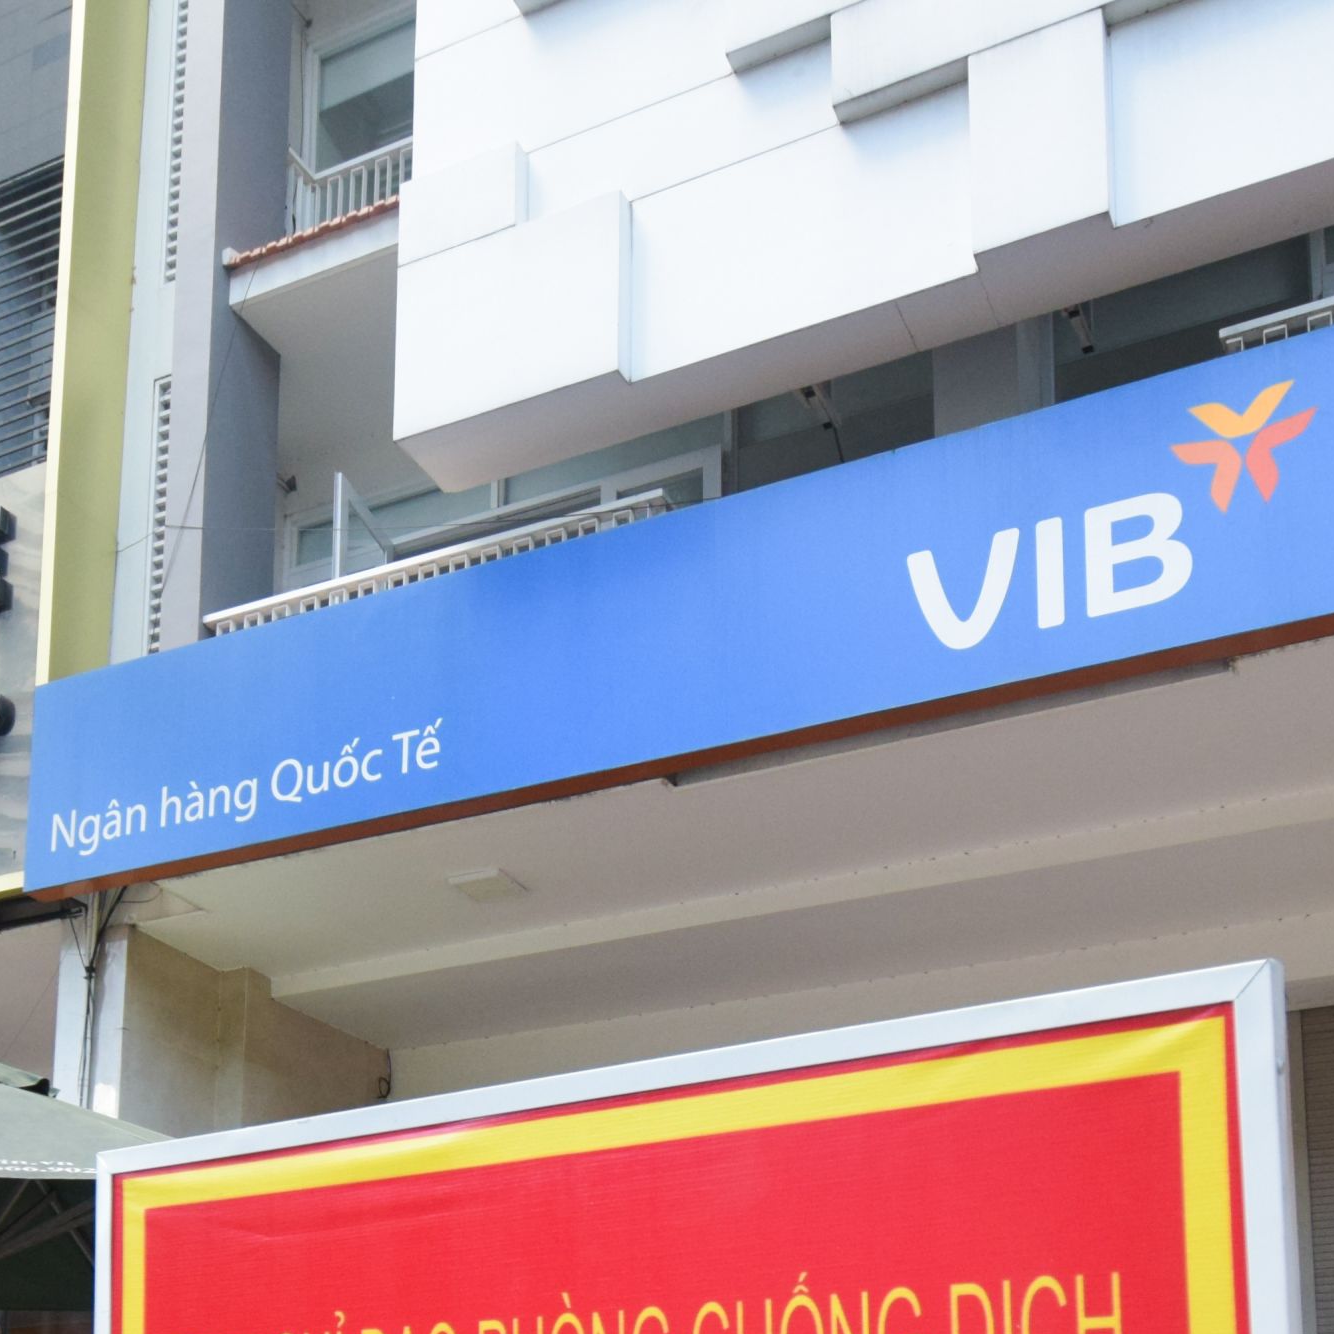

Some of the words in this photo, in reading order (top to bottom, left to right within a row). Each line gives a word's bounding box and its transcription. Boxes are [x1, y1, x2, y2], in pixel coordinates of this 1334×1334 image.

[906, 491, 1195, 651] VIB
[47, 792, 147, 859] Ngân
[159, 771, 259, 848] hàng
[270, 741, 384, 816] Quốc
[392, 717, 443, 781] Tế
